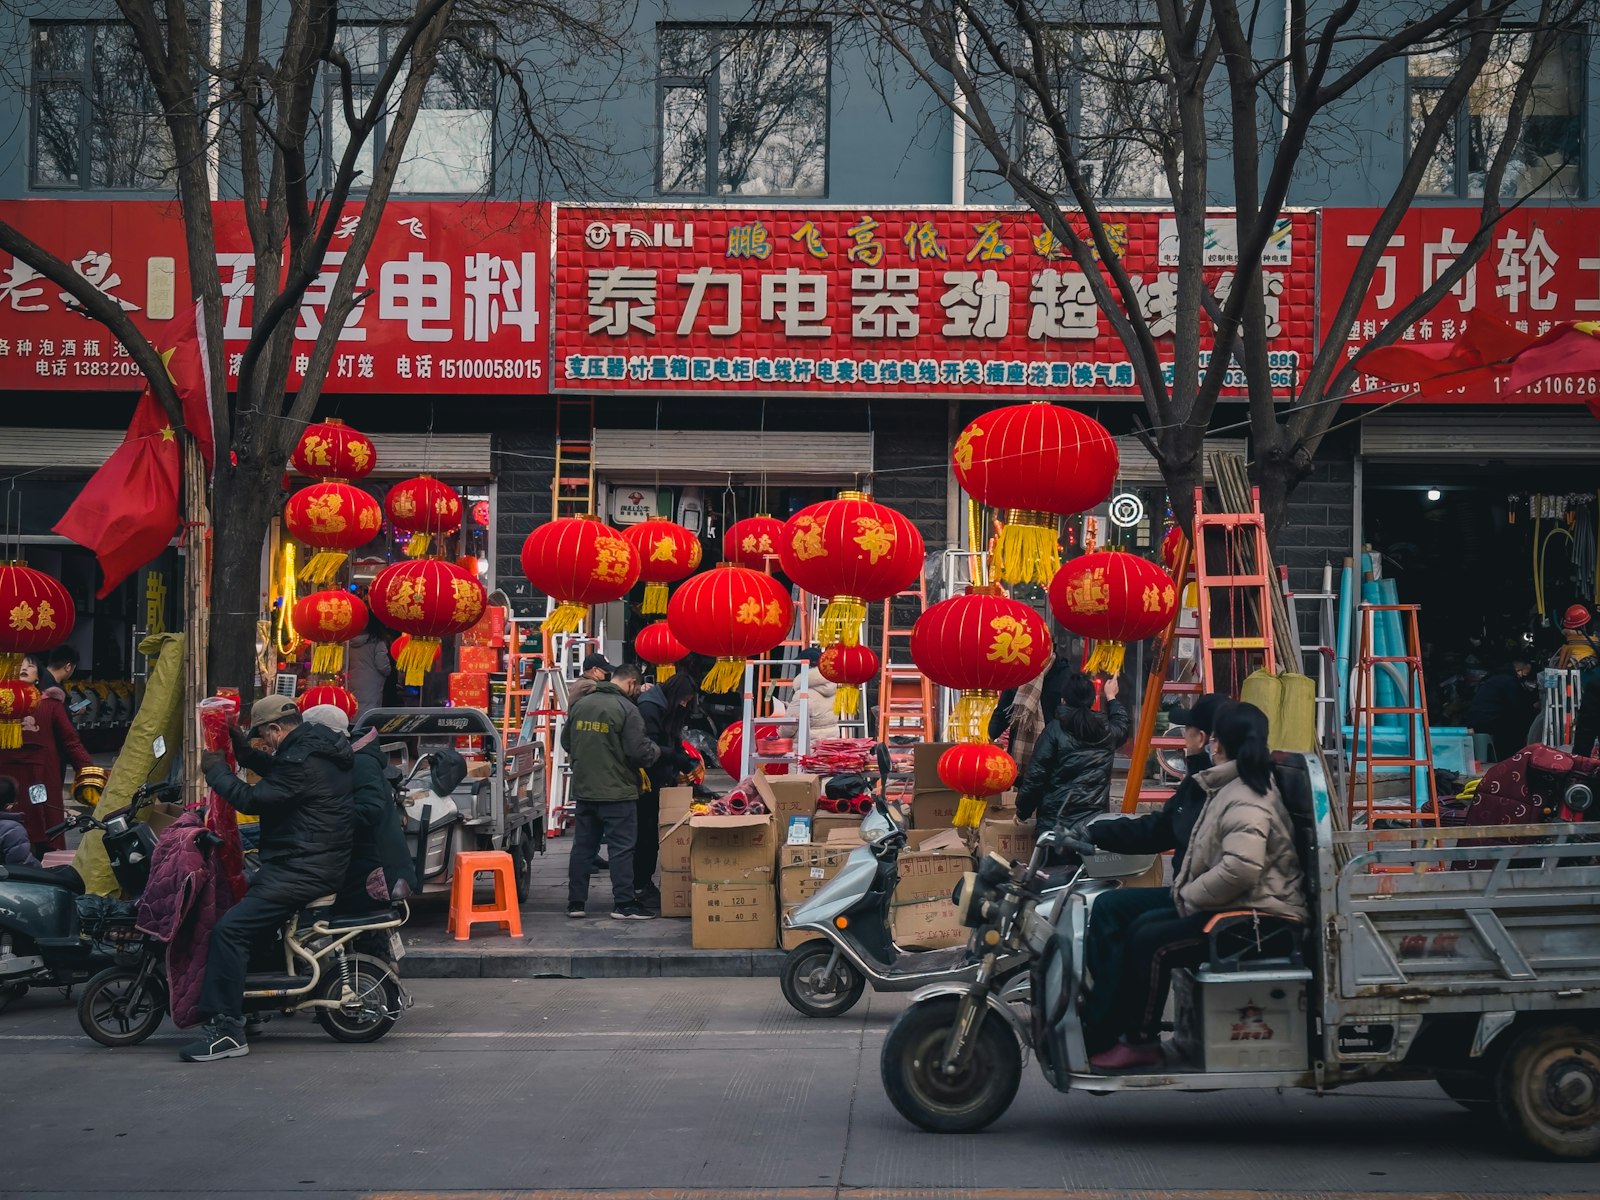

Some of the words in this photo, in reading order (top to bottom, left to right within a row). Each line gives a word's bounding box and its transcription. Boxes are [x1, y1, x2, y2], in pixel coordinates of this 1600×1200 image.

[216, 251, 540, 342] 五金电料
[36, 360, 67, 377] 电话
[337, 353, 374, 378] 灯笼
[397, 354, 432, 379] 电话
[439, 358, 542, 379] 15100058015
[566, 355, 626, 379] 变压器
[629, 356, 689, 380] 计量箱
[942, 360, 983, 385] 开关
[986, 362, 1026, 386] 插座
[1030, 362, 1071, 387] 浴霸
[1074, 362, 1134, 387] 换气扇
[732, 897, 745, 905] 120
